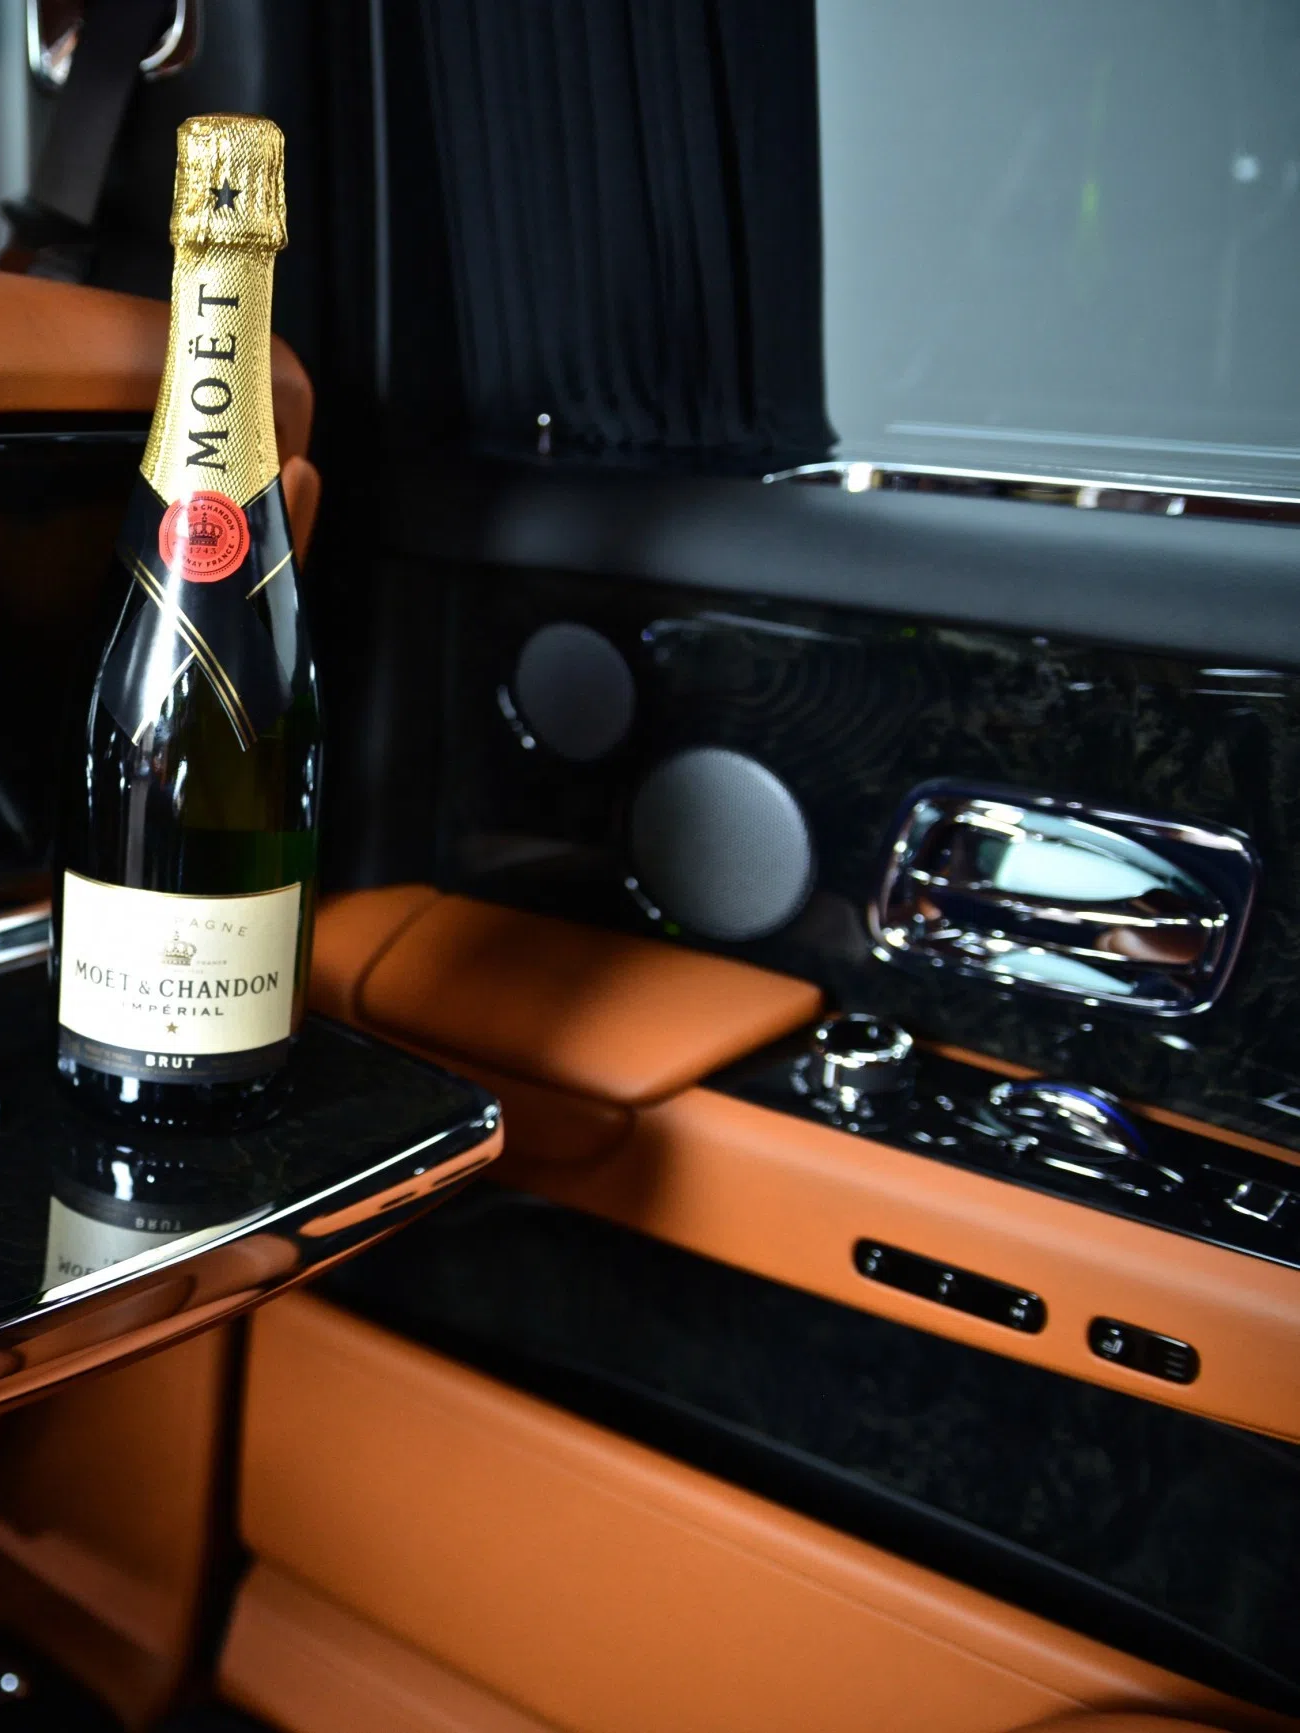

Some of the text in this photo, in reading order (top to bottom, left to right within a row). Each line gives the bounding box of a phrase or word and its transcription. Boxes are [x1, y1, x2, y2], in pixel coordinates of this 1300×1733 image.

[186, 283, 240, 474] MOËT
[201, 504, 235, 531] CHANDON
[189, 547, 217, 555] 1743
[206, 543, 235, 567] FRANCE
[138, 979, 151, 996] &
[158, 970, 279, 999] CHANDON
[145, 1054, 195, 1069] BRUT
